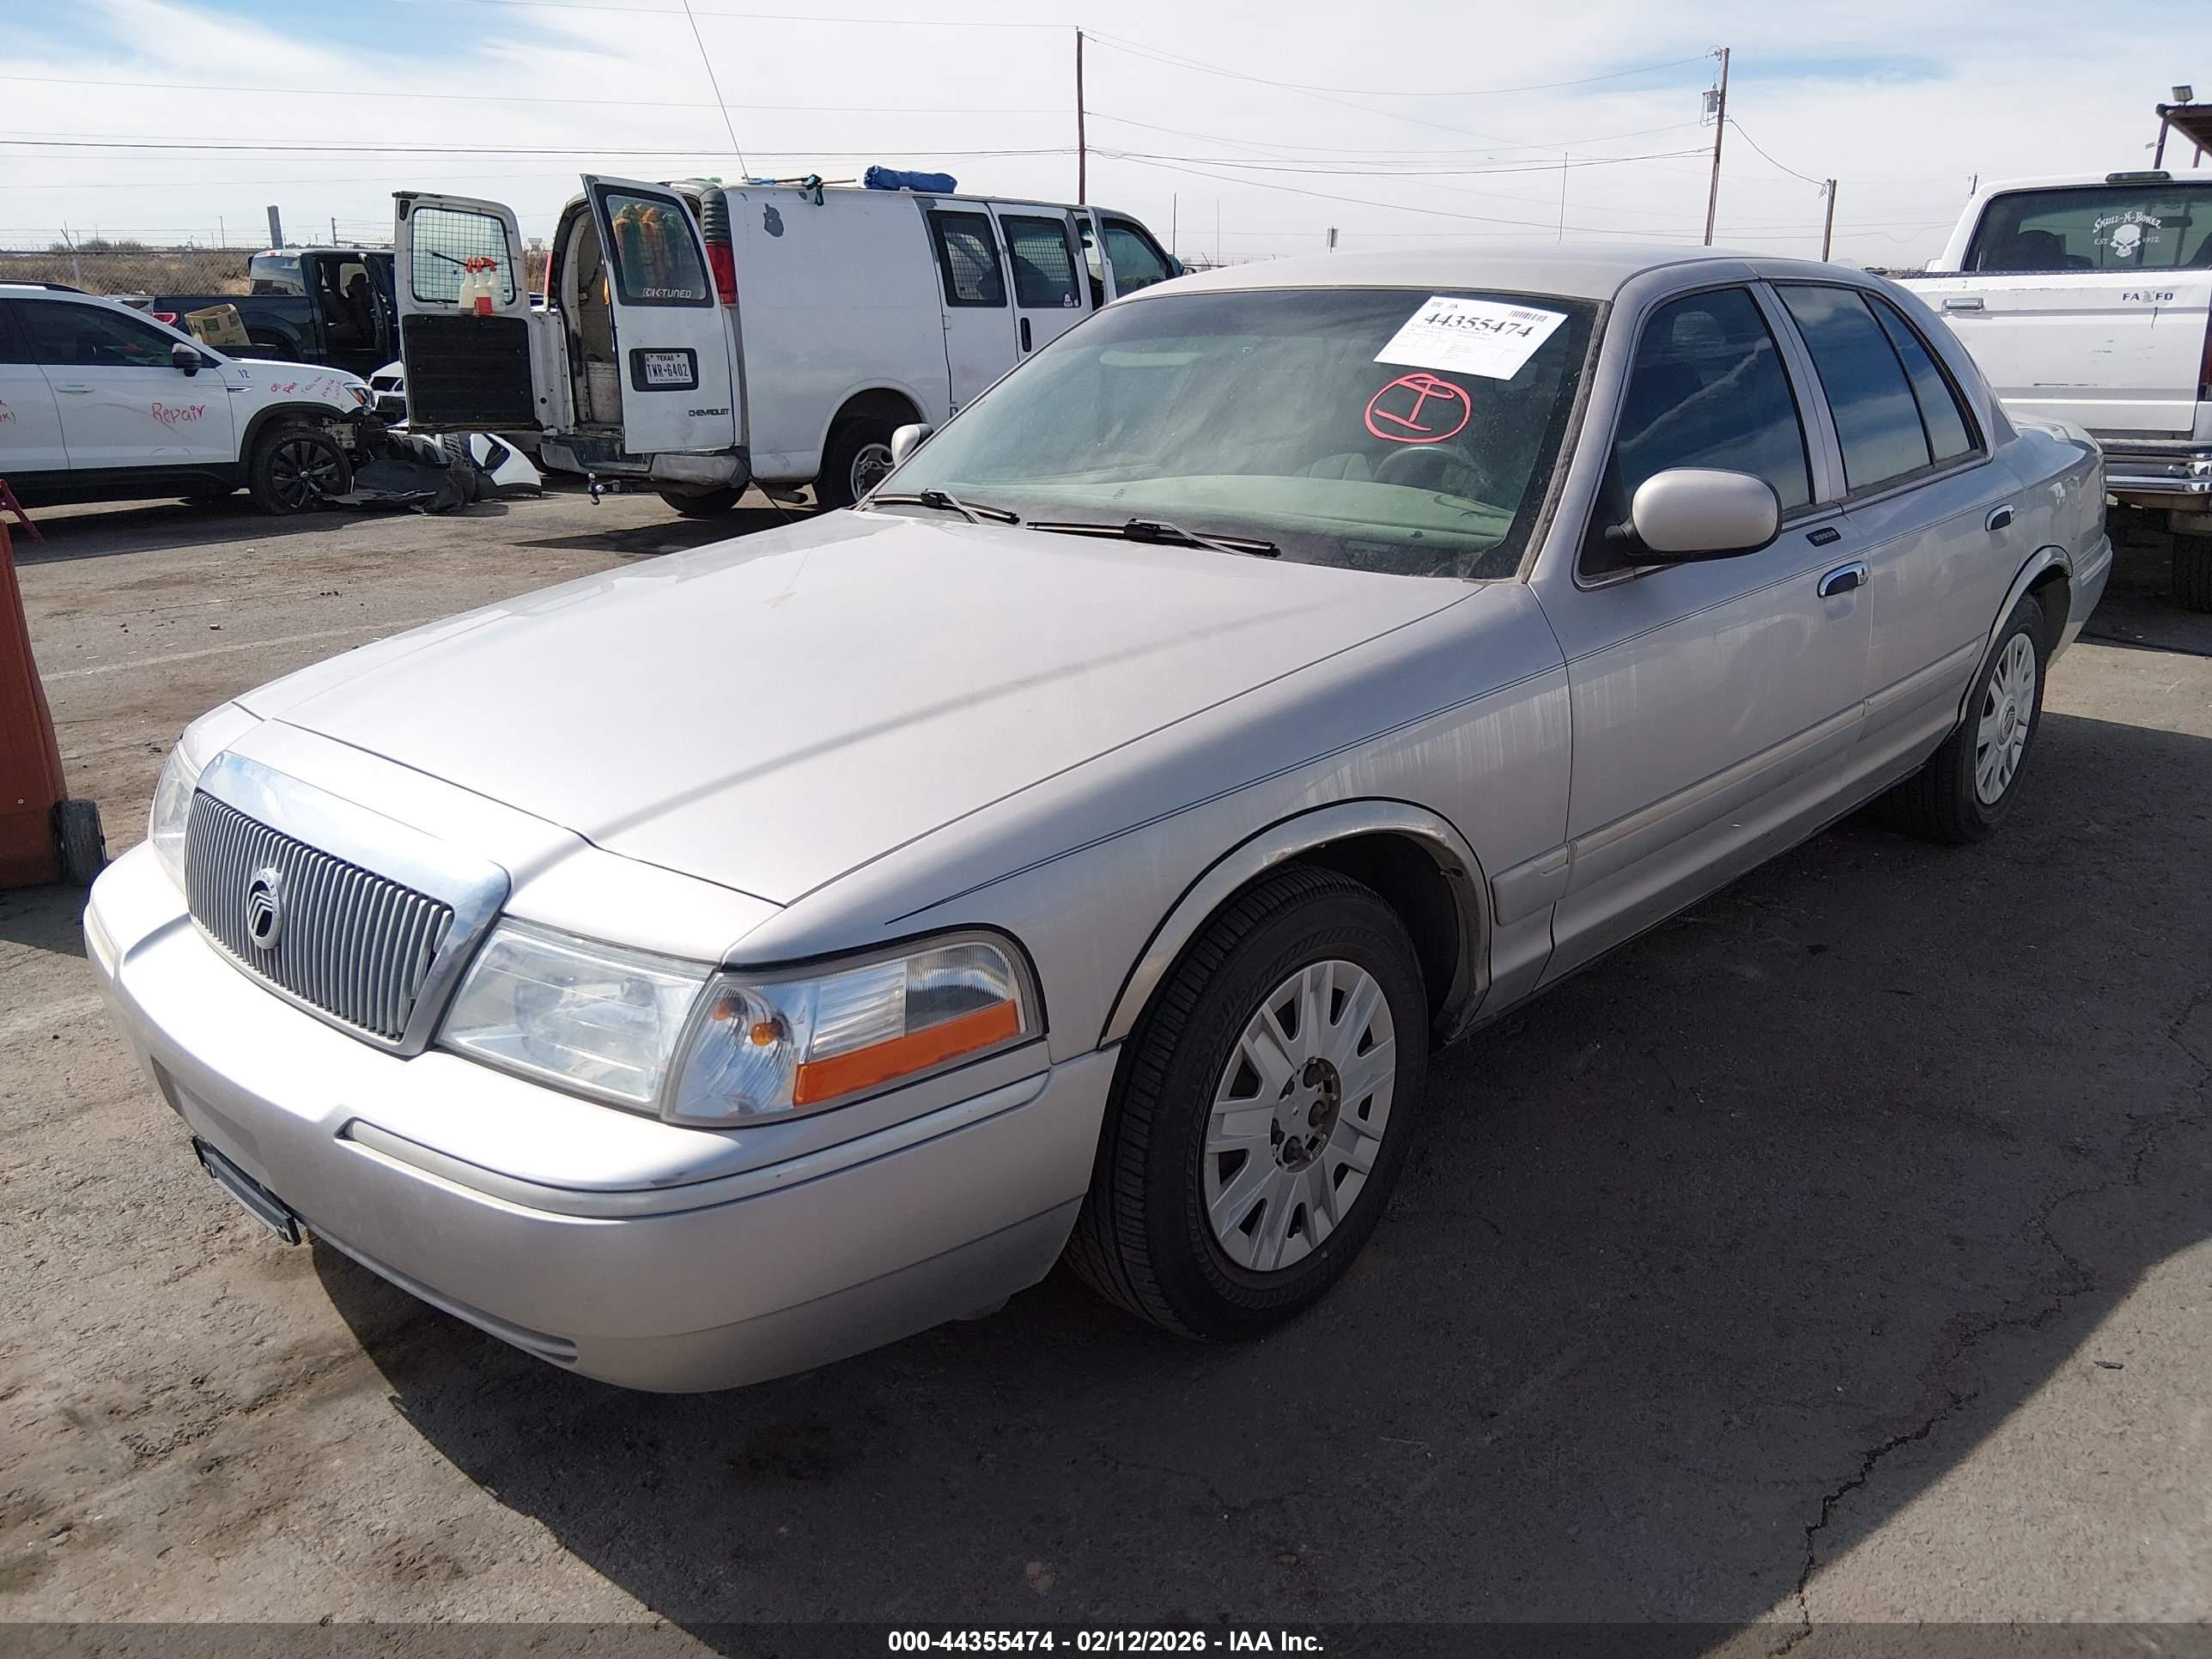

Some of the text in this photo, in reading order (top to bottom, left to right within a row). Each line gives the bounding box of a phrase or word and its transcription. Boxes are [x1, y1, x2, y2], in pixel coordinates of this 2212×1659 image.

[1424, 313, 1535, 337] 44355474
[238, 368, 251, 379] 12
[151, 402, 206, 424] Repair
